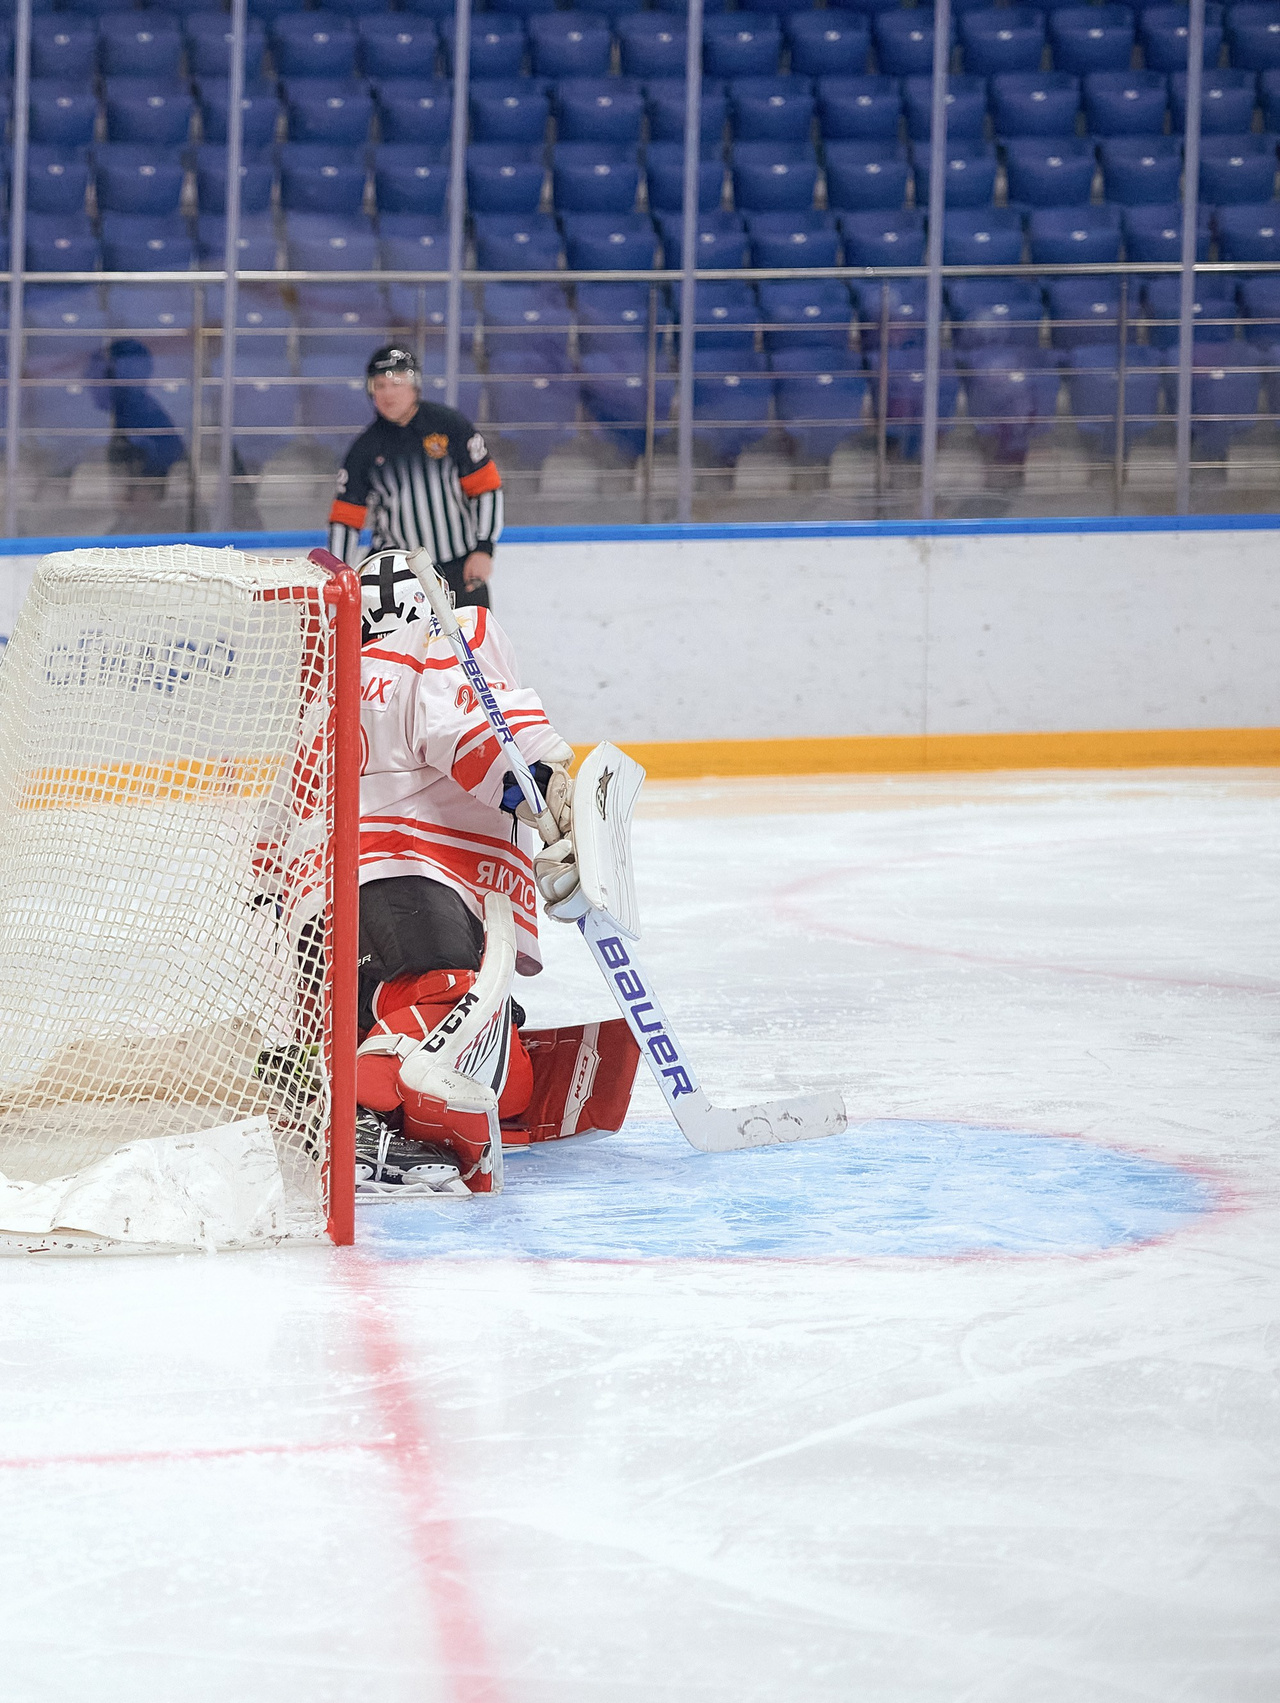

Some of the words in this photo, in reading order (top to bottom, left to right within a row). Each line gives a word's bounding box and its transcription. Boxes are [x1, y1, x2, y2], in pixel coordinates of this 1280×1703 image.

[420, 992, 480, 1053] CCM
[595, 936, 694, 1100] BAUER
[574, 1056, 589, 1100] CCM
